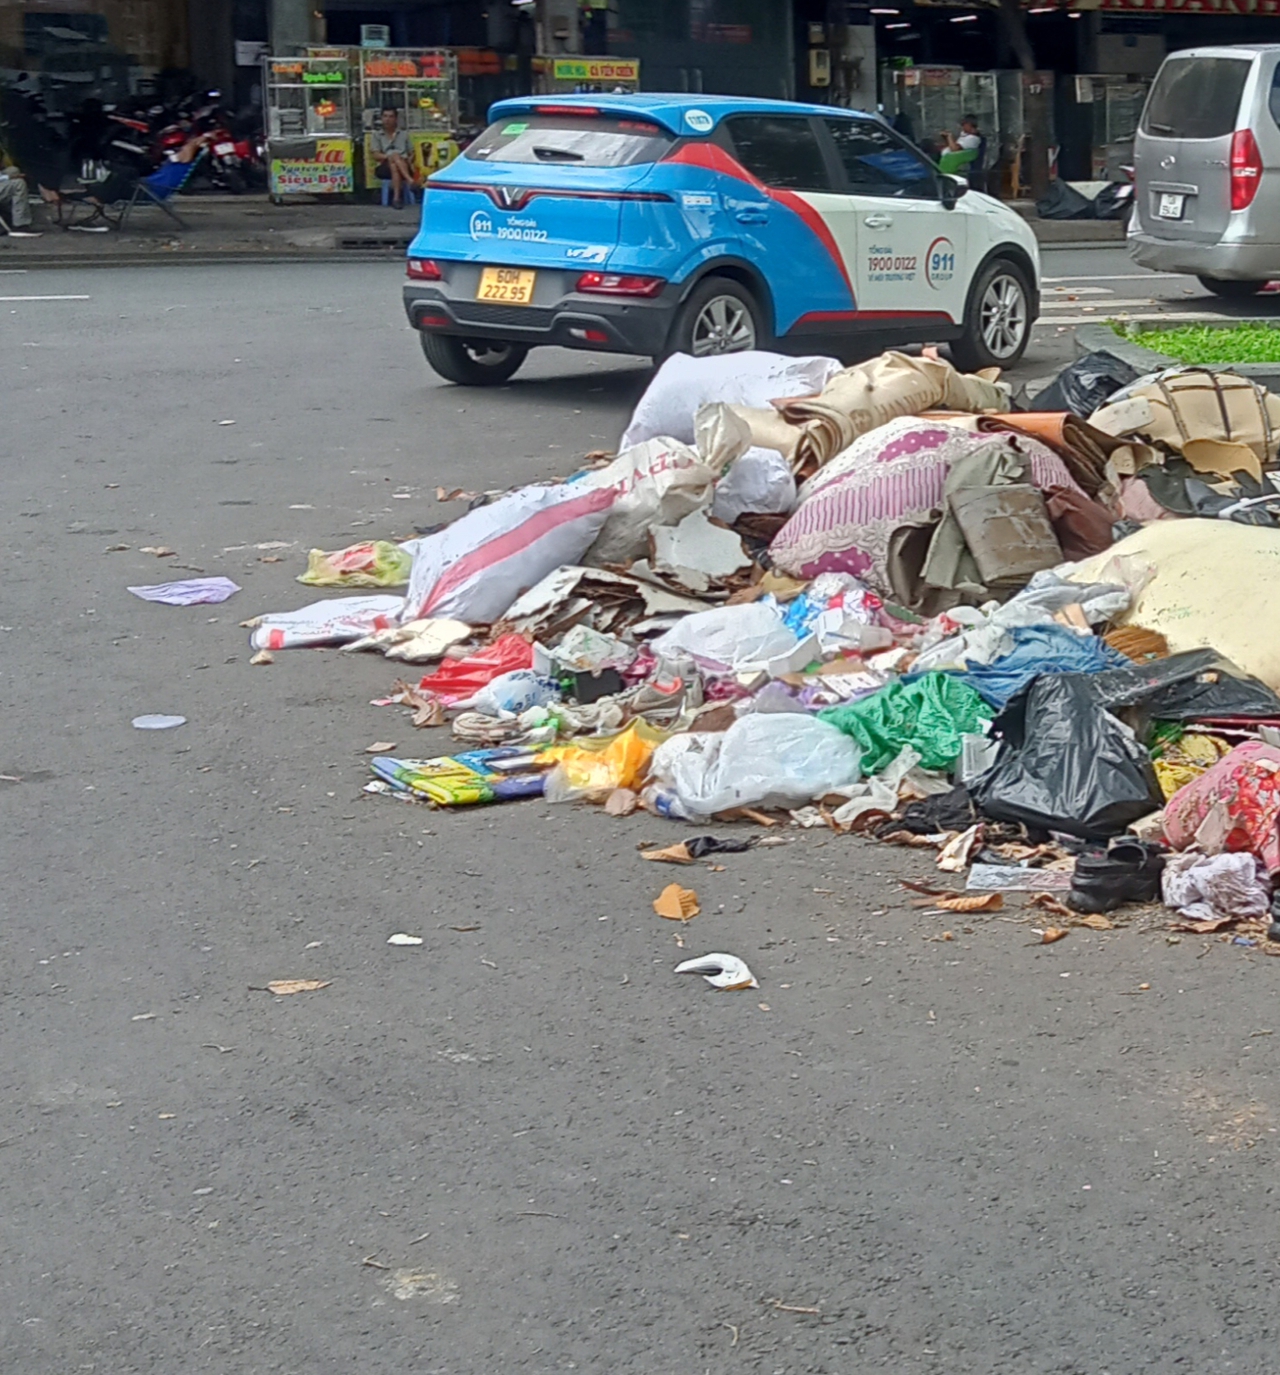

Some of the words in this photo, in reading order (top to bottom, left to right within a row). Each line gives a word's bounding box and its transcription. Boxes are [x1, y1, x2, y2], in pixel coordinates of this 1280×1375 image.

[868, 257, 892, 271] 1900
[894, 257, 917, 271] 0122
[931, 253, 955, 271] 911
